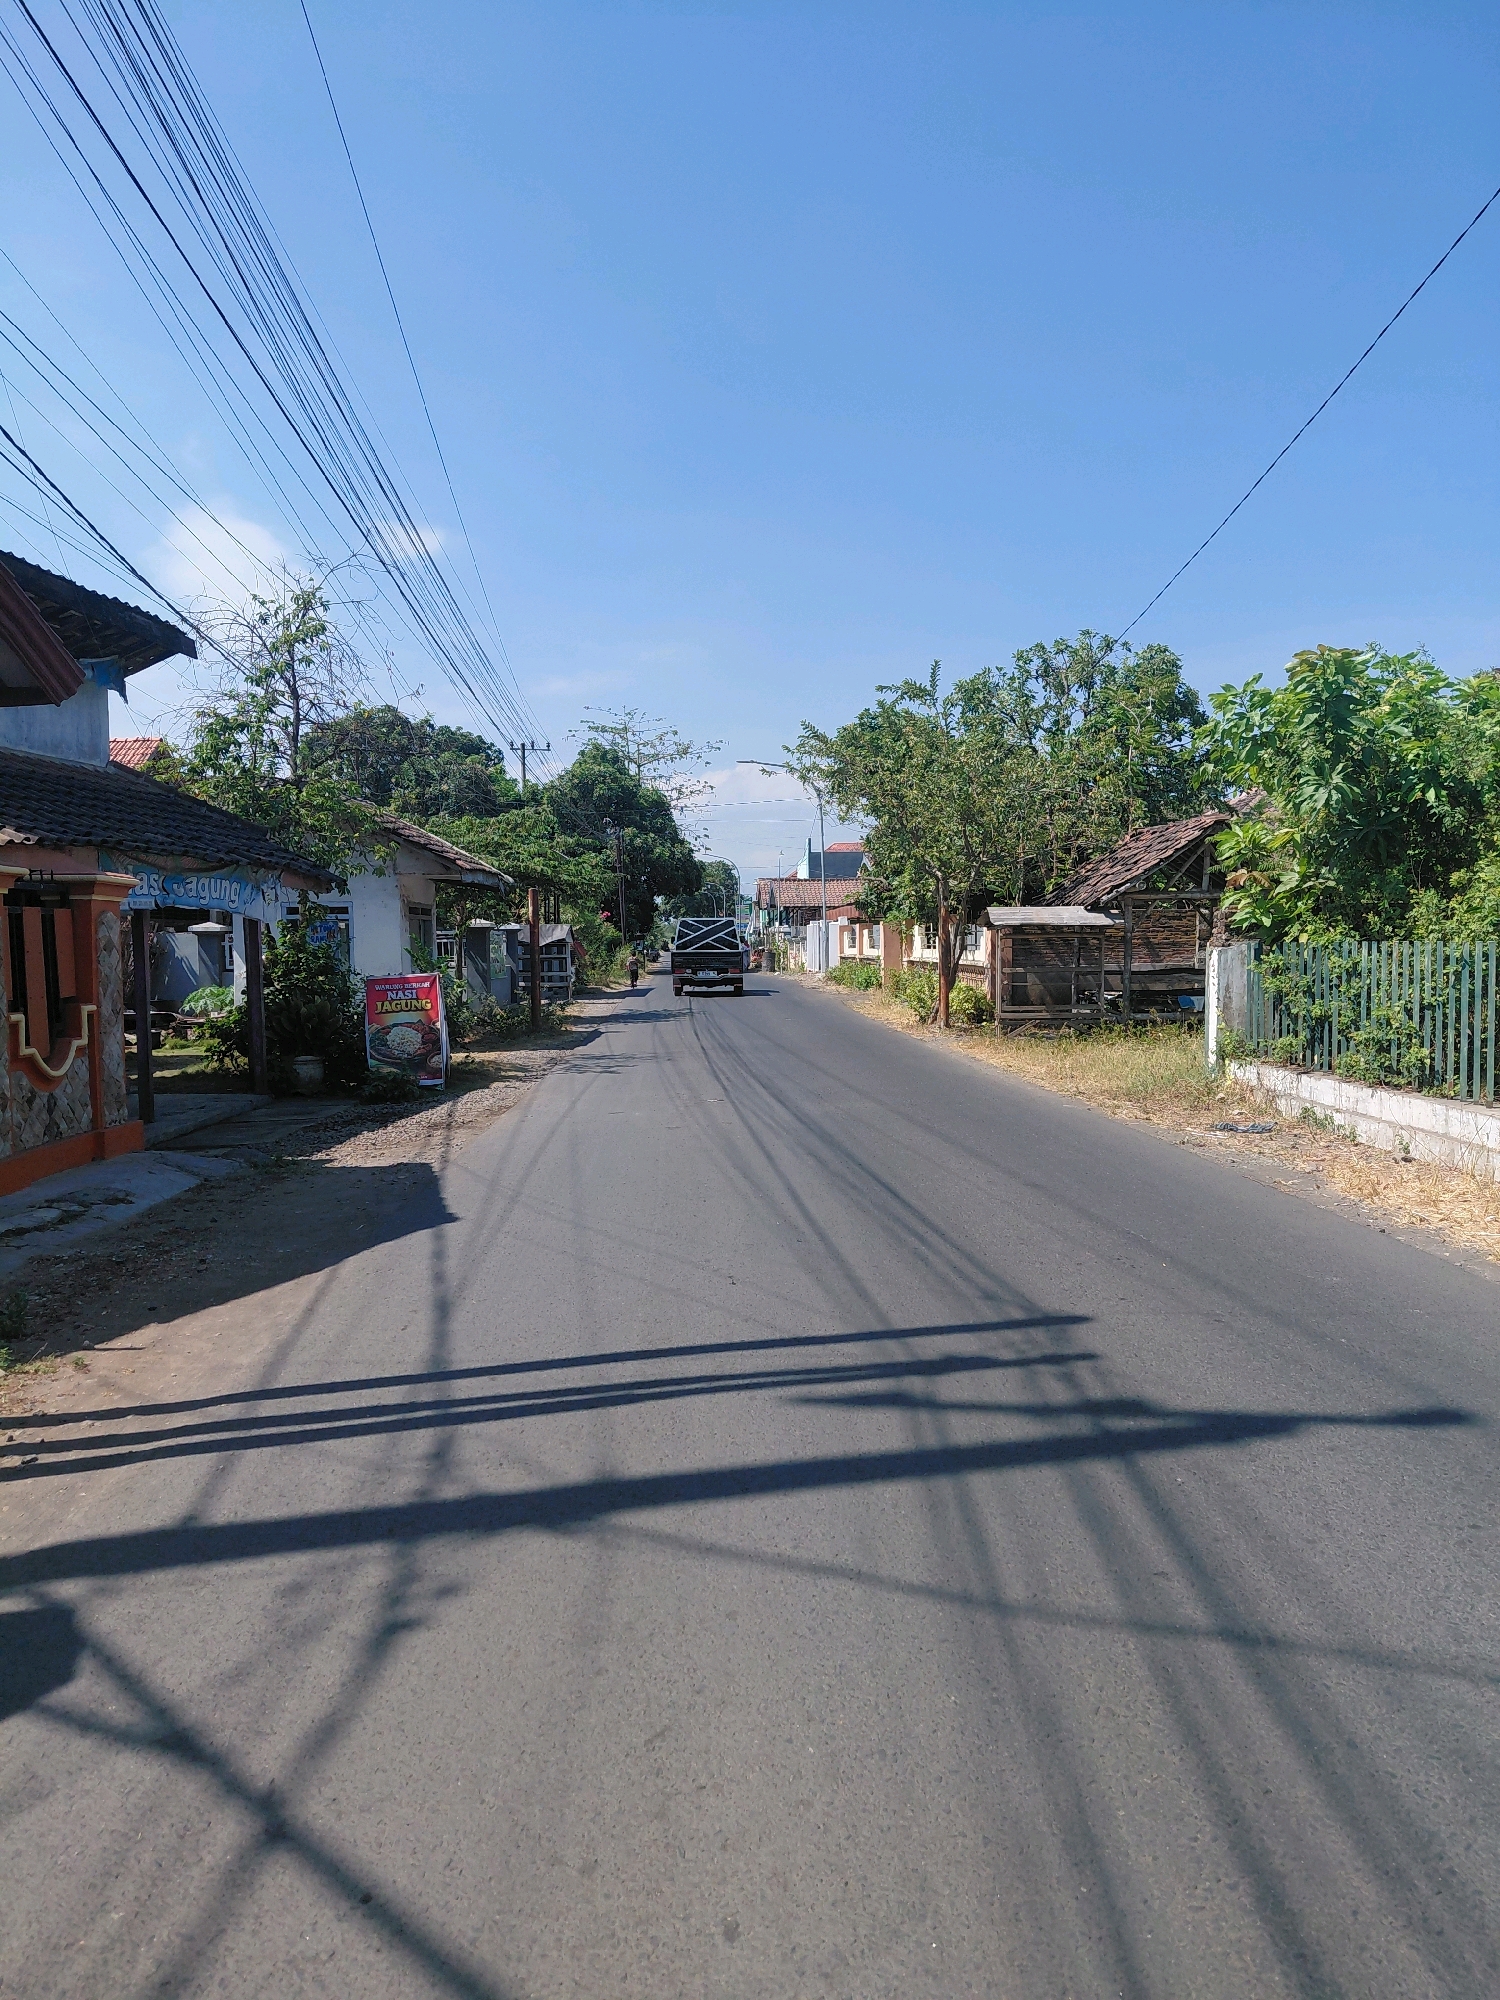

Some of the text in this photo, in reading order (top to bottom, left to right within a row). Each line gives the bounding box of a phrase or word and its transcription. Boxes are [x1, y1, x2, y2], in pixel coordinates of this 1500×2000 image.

[128, 865, 170, 896] as
[387, 990, 417, 1000] NASI
[375, 999, 432, 1013] JAGUNG
